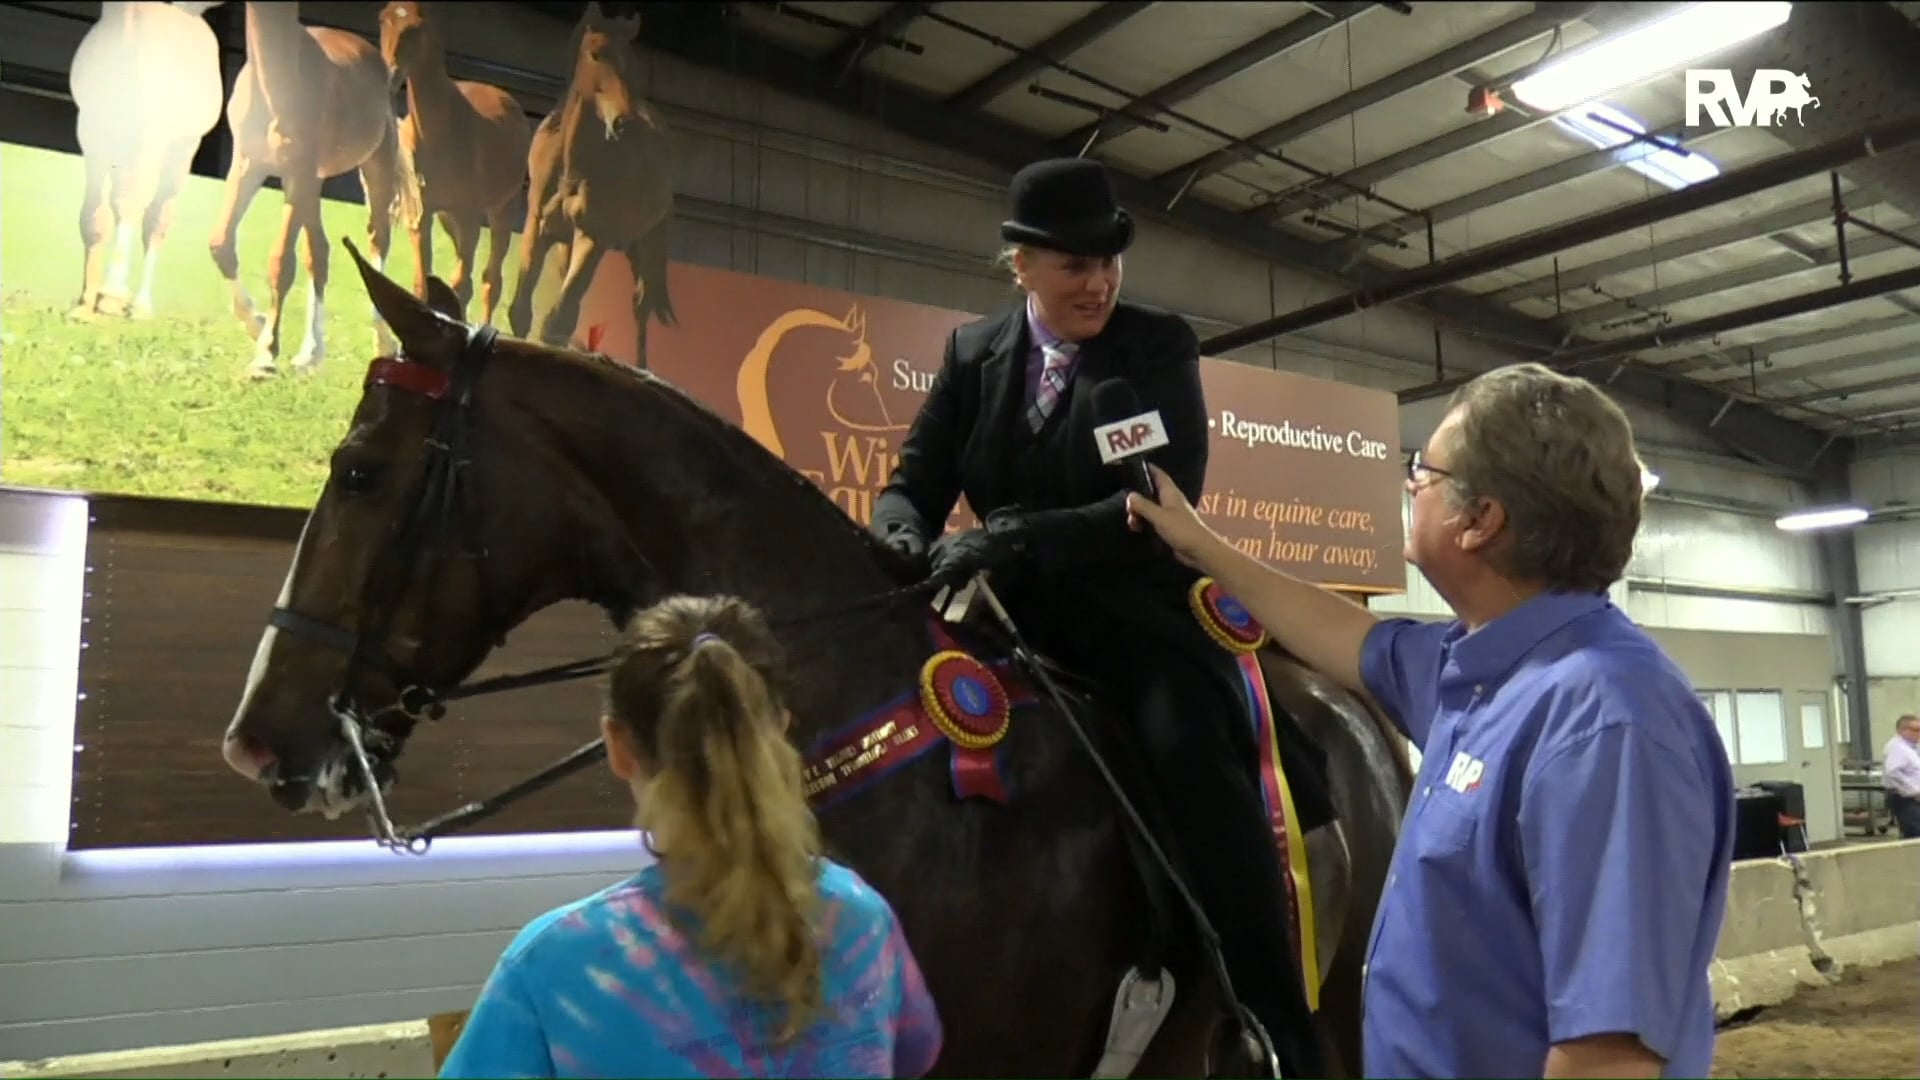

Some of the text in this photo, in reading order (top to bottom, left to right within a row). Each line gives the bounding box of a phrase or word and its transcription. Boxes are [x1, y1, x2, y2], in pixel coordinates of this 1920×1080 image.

[1106, 422, 1152, 454] RVP
[1221, 410, 1388, 460] Reproductive Care
[1226, 489, 1248, 519] in
[1252, 497, 1324, 530] equine
[1328, 508, 1376, 534] care,
[1235, 530, 1379, 576] an hour away.
